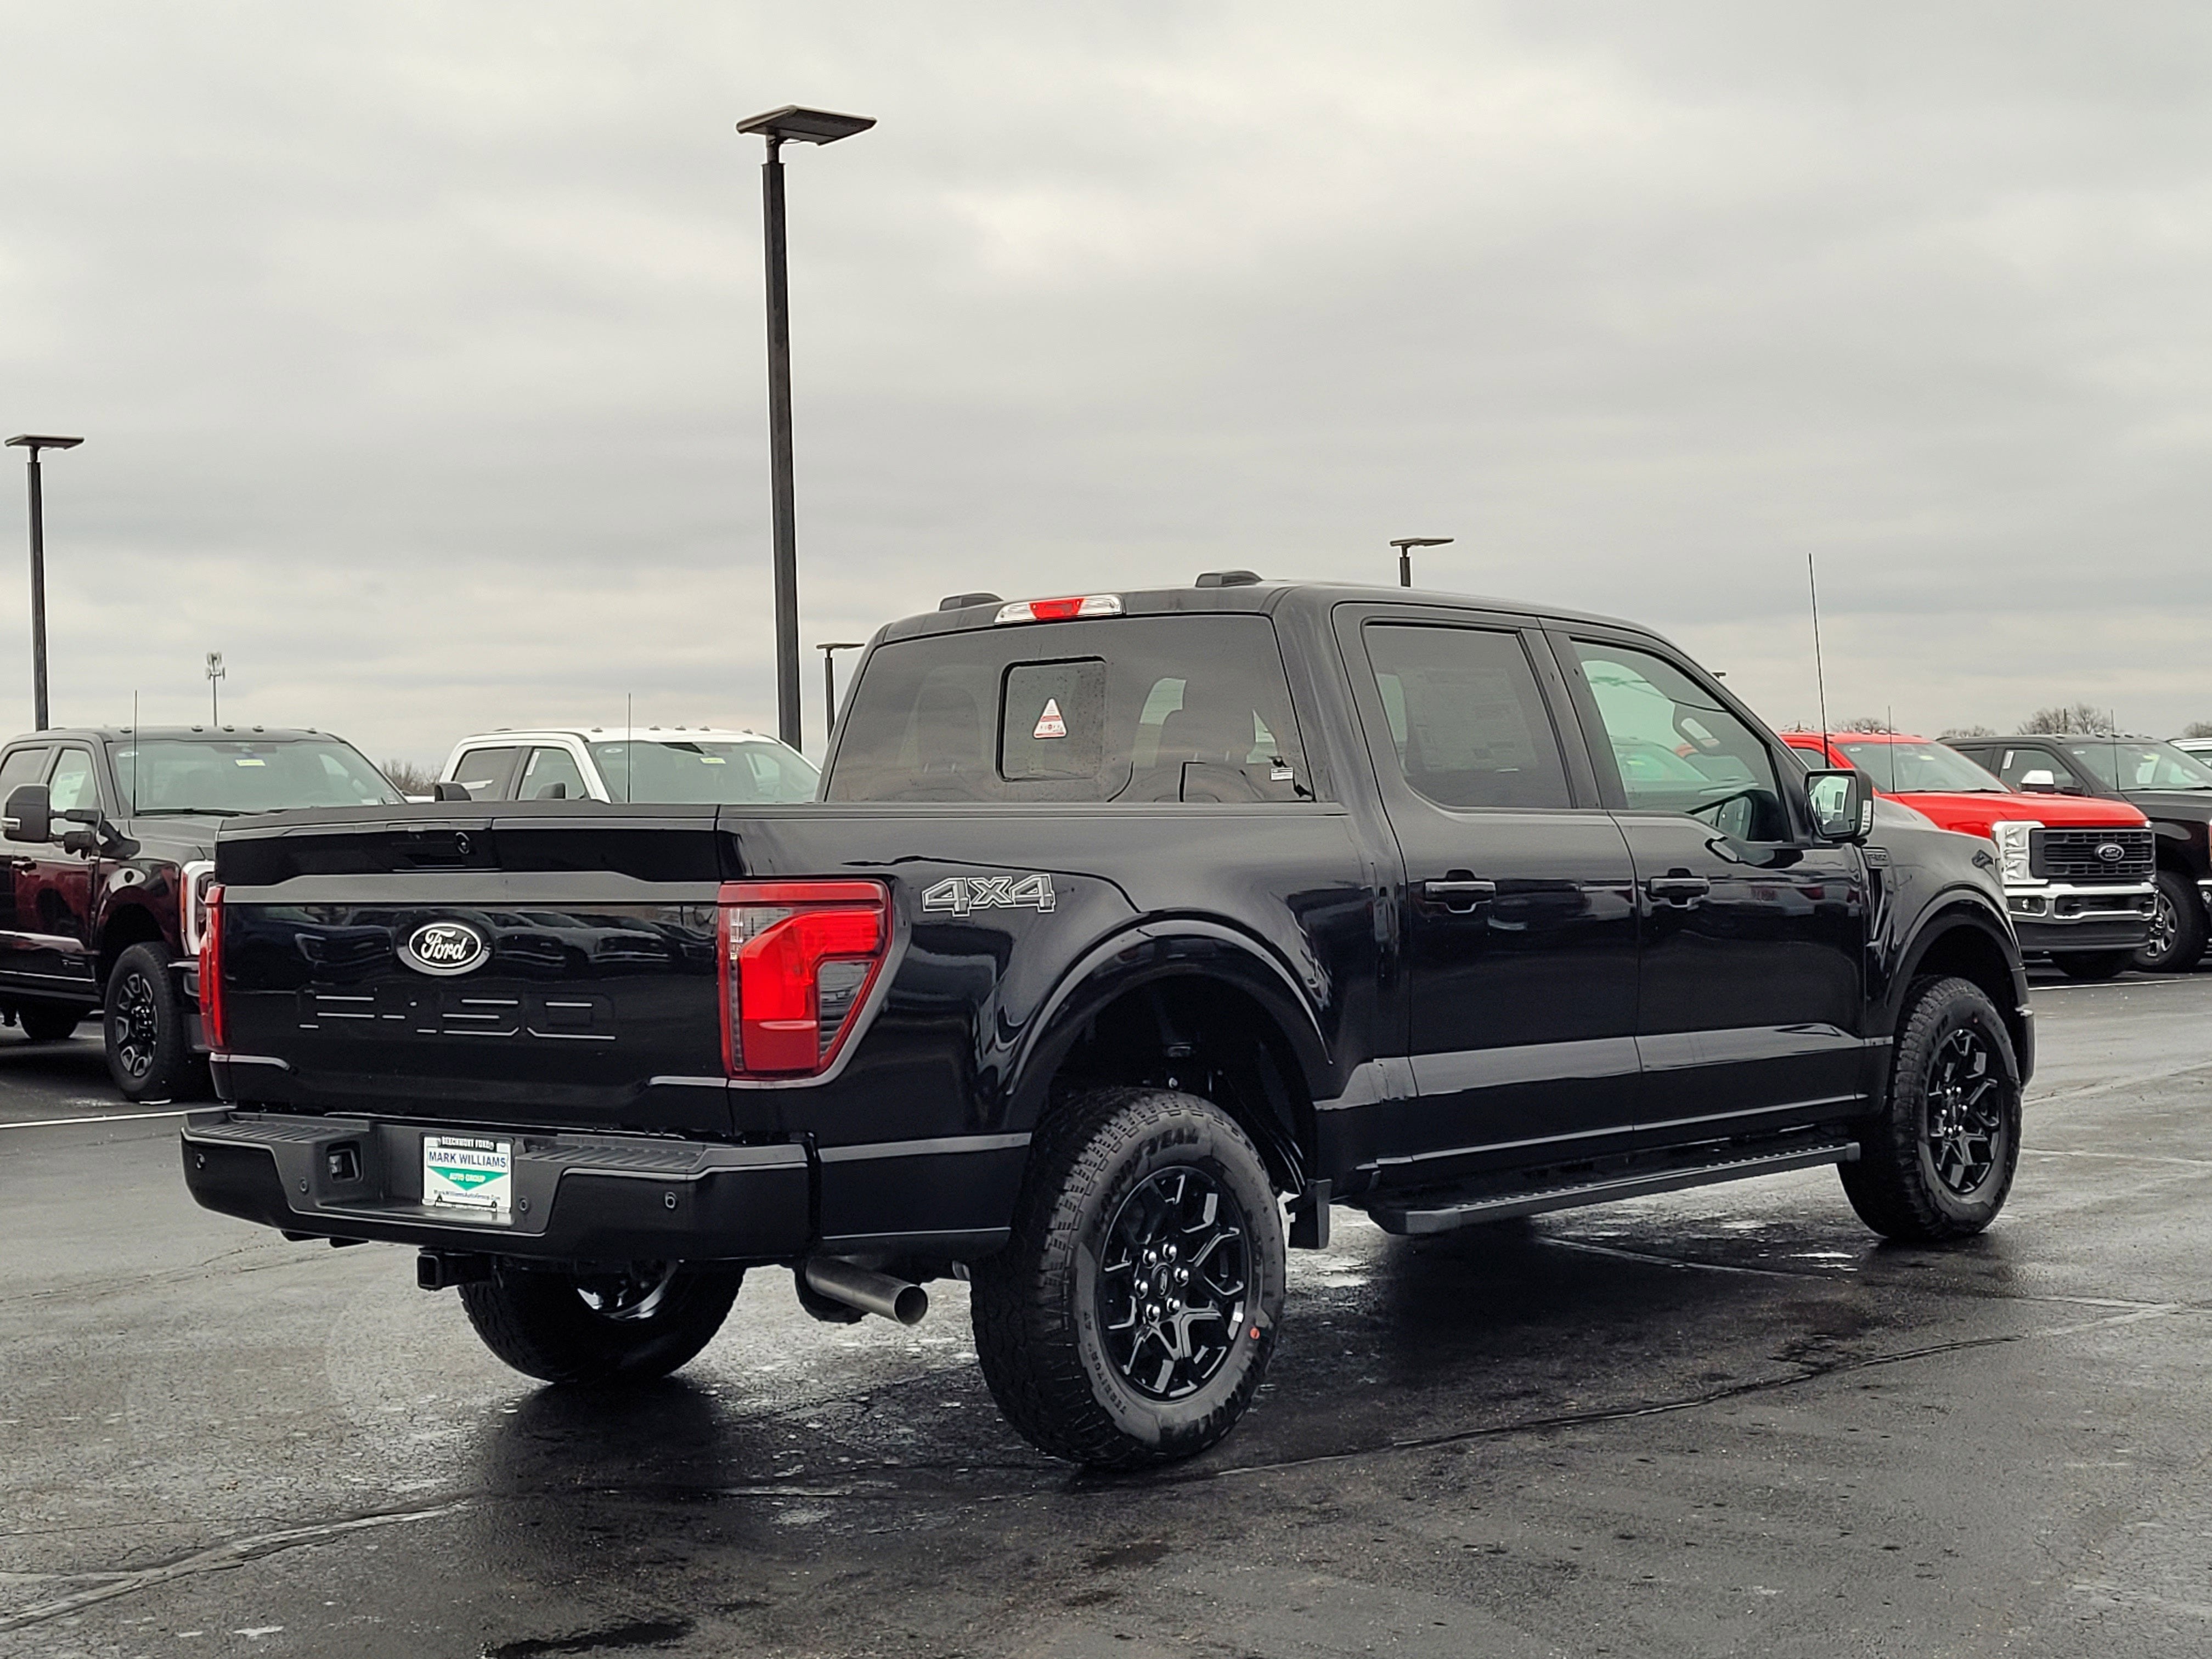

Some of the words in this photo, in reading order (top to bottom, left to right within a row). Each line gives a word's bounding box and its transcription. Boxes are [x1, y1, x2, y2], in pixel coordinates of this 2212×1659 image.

[421, 929, 467, 960] Ford
[429, 1152, 456, 1164] MARK
[460, 1154, 506, 1167] WILLIAMS
